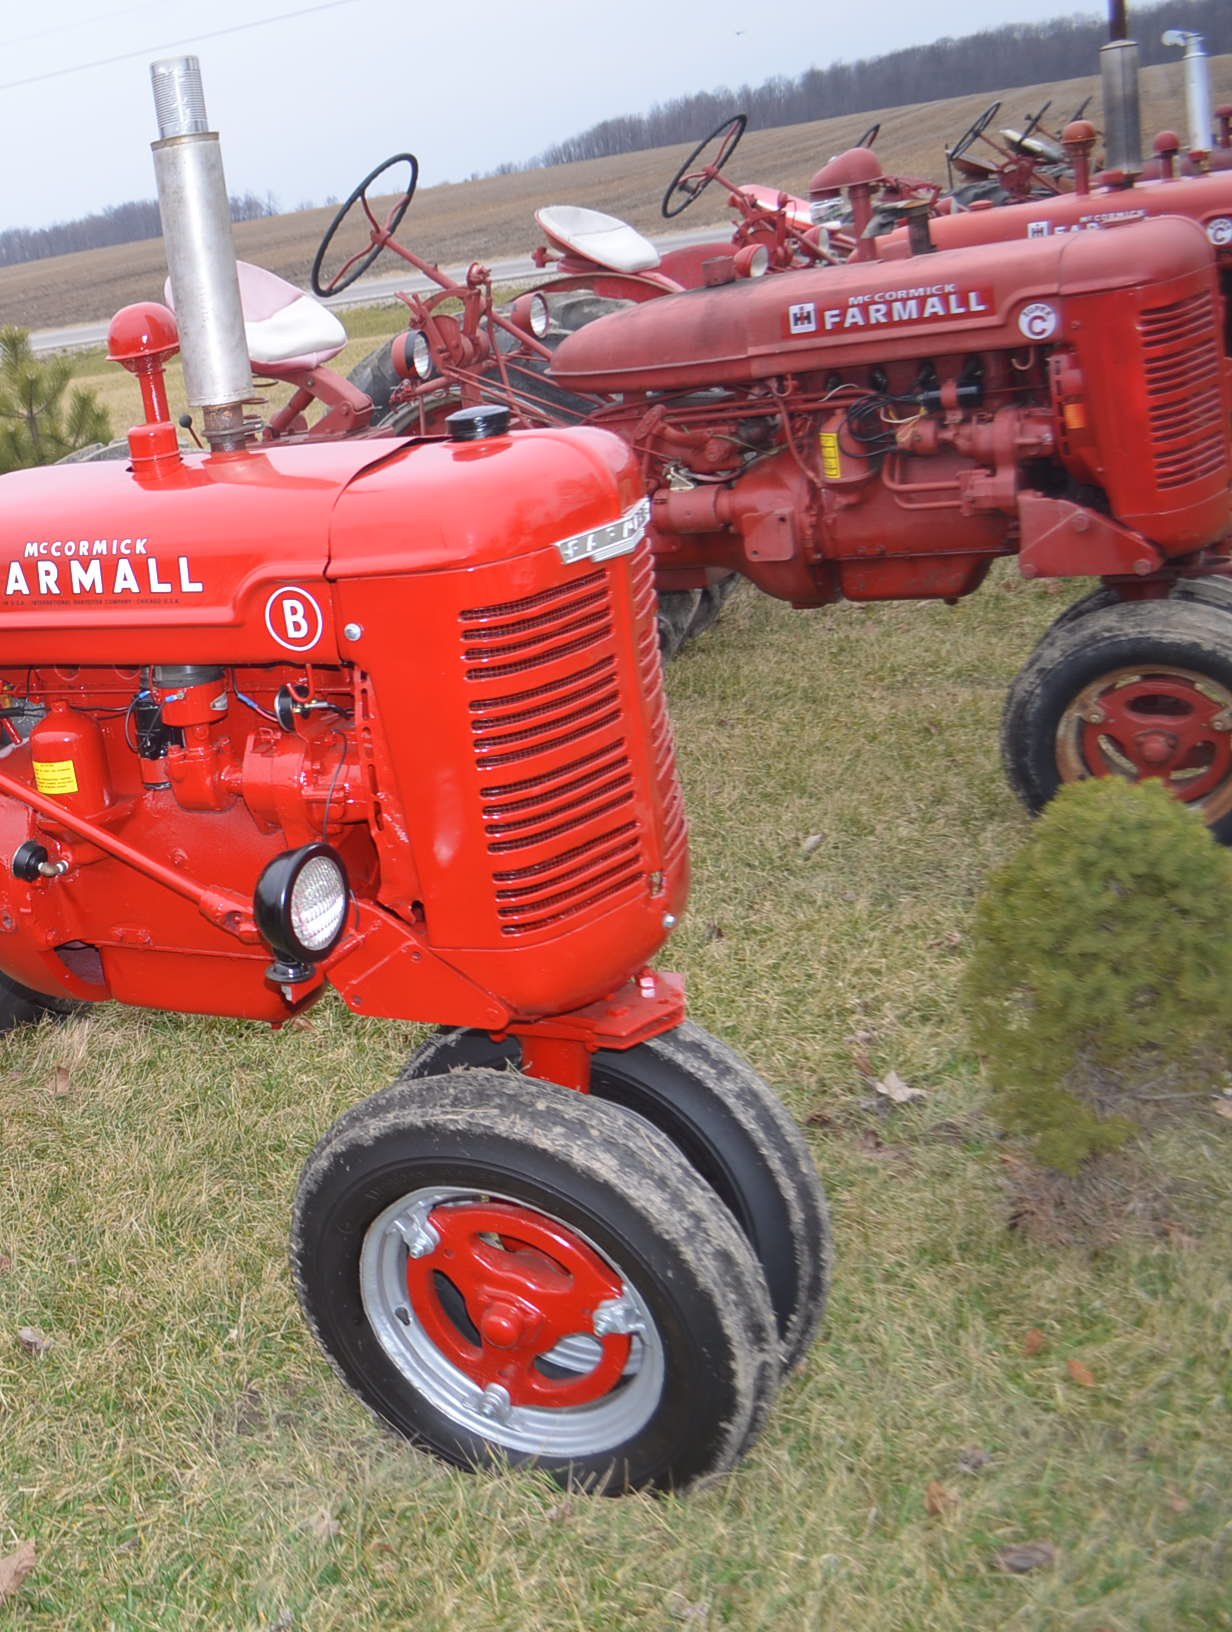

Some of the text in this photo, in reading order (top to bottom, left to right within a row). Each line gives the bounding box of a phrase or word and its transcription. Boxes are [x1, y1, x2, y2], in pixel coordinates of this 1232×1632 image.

[824, 292, 987, 330] FARMALL
[1028, 315, 1048, 337] C
[24, 538, 148, 557] McCORMICK
[282, 599, 308, 638] B
